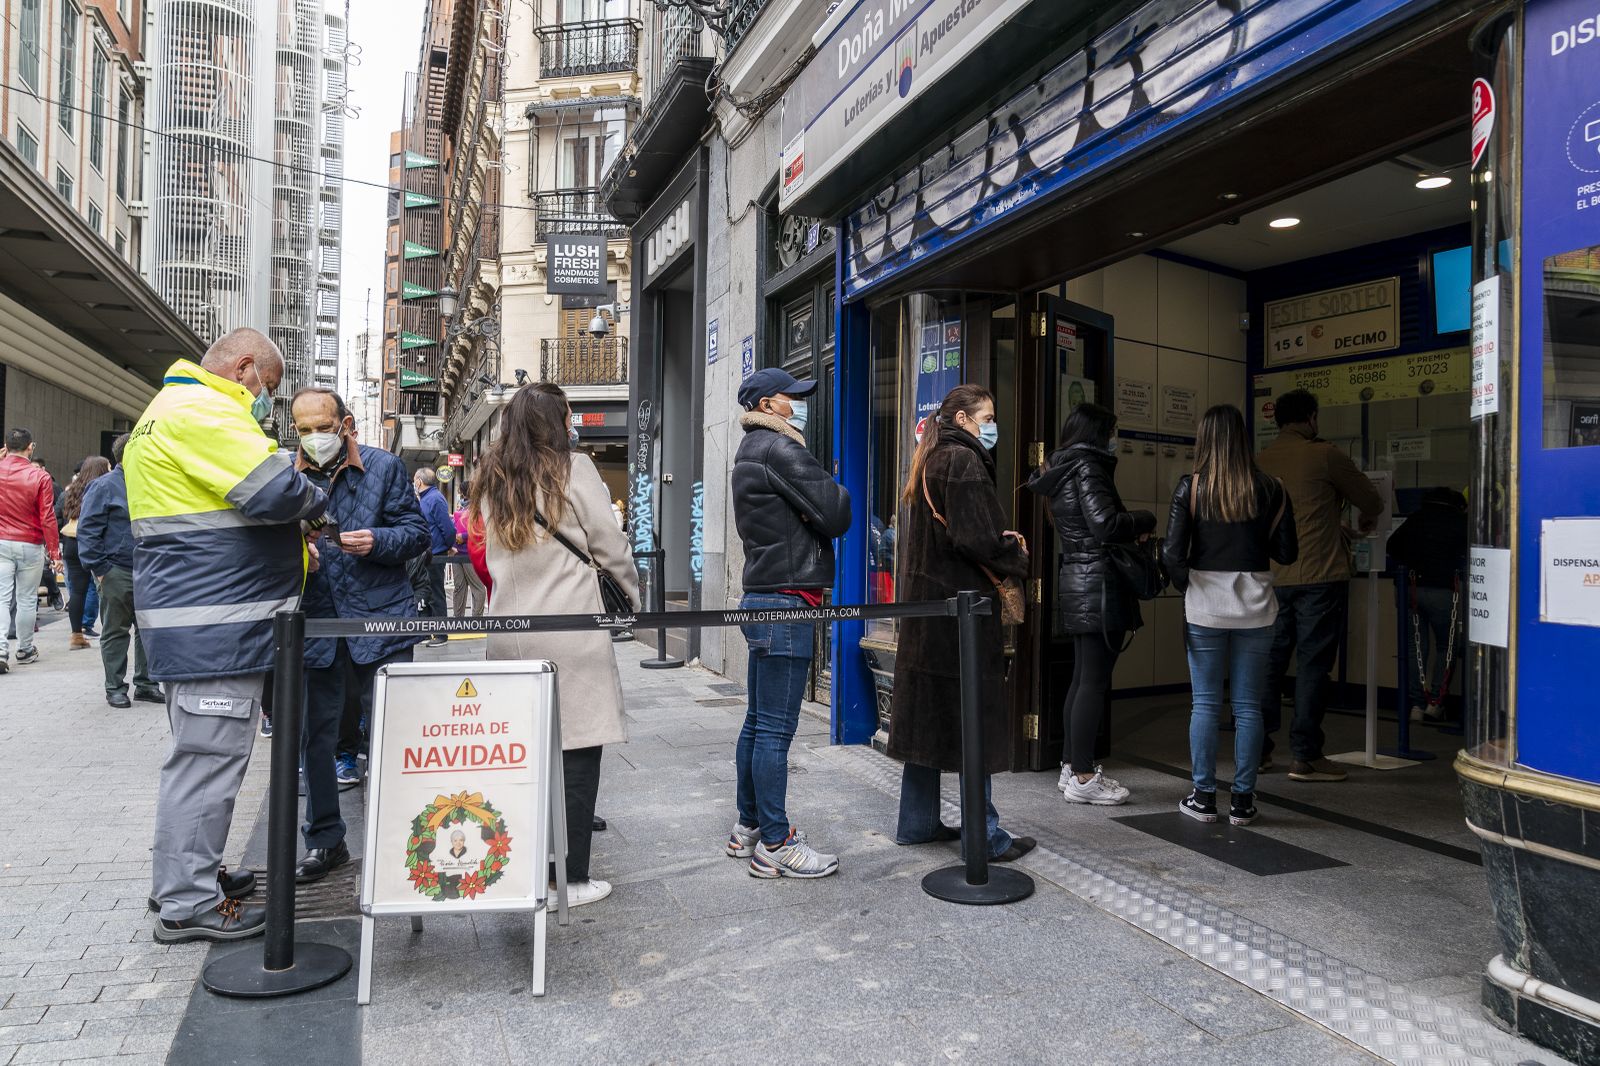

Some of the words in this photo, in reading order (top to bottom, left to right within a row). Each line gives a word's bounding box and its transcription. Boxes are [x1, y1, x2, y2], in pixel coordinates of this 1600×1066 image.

[838, 8, 884, 79] Doña
[844, 78, 884, 127] Loterías
[886, 68, 893, 94] y
[920, 0, 982, 58] Apuestas
[1576, 199, 1589, 210] EL
[647, 200, 691, 276] LUSH
[554, 244, 600, 257] LUSH
[554, 257, 600, 269] FRESH
[554, 269, 600, 277] HANDMADE
[554, 276, 600, 285] COSMETICS
[1270, 300, 1314, 326] ESTE
[1319, 285, 1388, 316] SORTEO
[1274, 339, 1290, 352] 15
[1295, 336, 1304, 347] €
[1335, 330, 1387, 349] DECIMO
[1417, 353, 1451, 364] PREMIO
[1303, 369, 1332, 378] PREMIO
[1357, 361, 1389, 372] PREMIO
[1408, 362, 1449, 378] 37023
[1296, 377, 1330, 391] 55483
[1349, 370, 1387, 385] 86986
[723, 608, 860, 622] WWW.LOTERIAMANOLITA.COM
[364, 619, 530, 633] WWW.LOTERIAMANOLITA.COM
[451, 703, 481, 717] HAY
[422, 722, 485, 737] LOTERIA
[490, 721, 509, 734] DE
[403, 743, 527, 769] NAVIDAD
